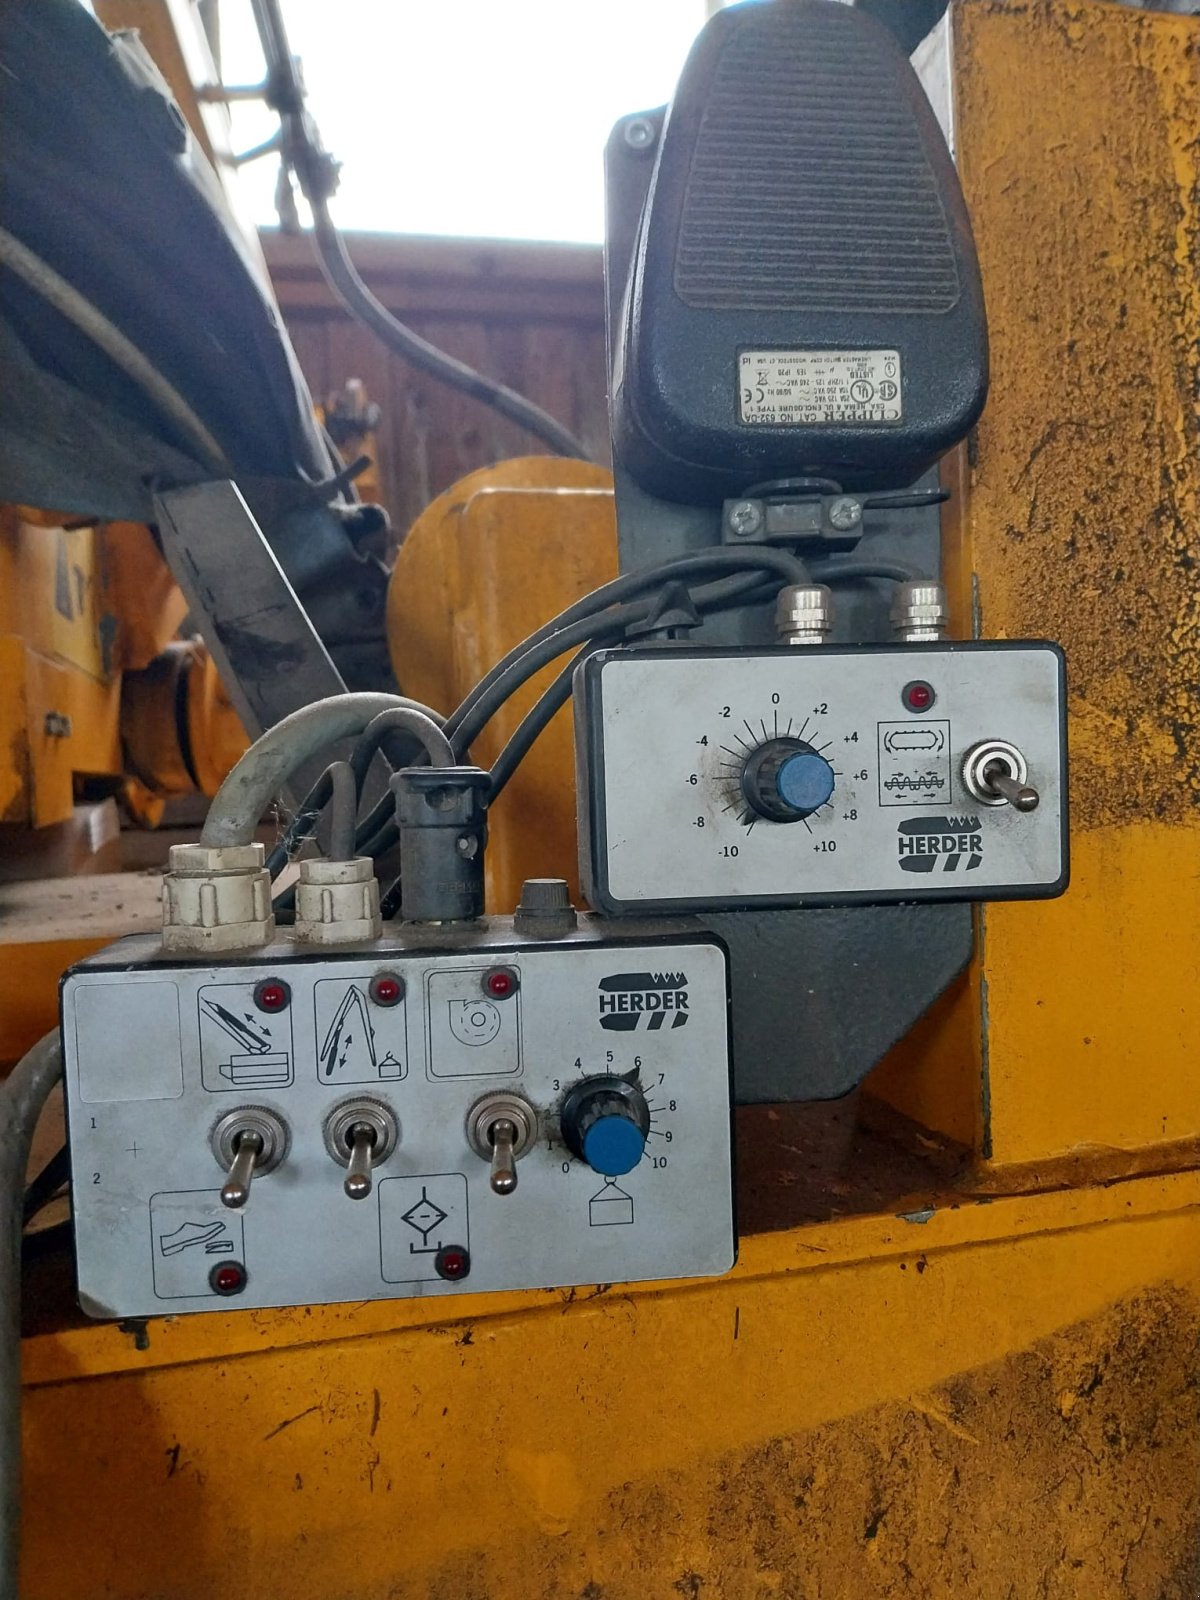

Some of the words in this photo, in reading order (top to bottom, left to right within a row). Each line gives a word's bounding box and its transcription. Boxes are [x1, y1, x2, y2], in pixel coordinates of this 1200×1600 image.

[823, 409, 898, 420] CLIPPER
[771, 693, 780, 704] 0
[718, 706, 731, 717] -2
[813, 703, 828, 715] +2
[696, 735, 708, 746] -4
[843, 732, 858, 743] +4
[685, 774, 698, 786] -6
[853, 770, 868, 781] +6
[842, 809, 858, 820] +8
[692, 816, 705, 828] -8
[813, 840, 837, 853] +10
[898, 834, 983, 854] HERDER
[718, 846, 739, 858] -10
[599, 992, 689, 1012] HERDER
[607, 1051, 613, 1062] 5
[634, 1056, 641, 1068] 6
[575, 1058, 581, 1068] 4
[659, 1074, 665, 1084] 7
[553, 1080, 560, 1090] 3
[670, 1100, 676, 1111] 8
[90, 1117, 97, 1129] 1
[665, 1132, 672, 1142] 9
[562, 1162, 570, 1173] 0
[653, 1157, 667, 1168] 10
[93, 1172, 101, 1184] 2
